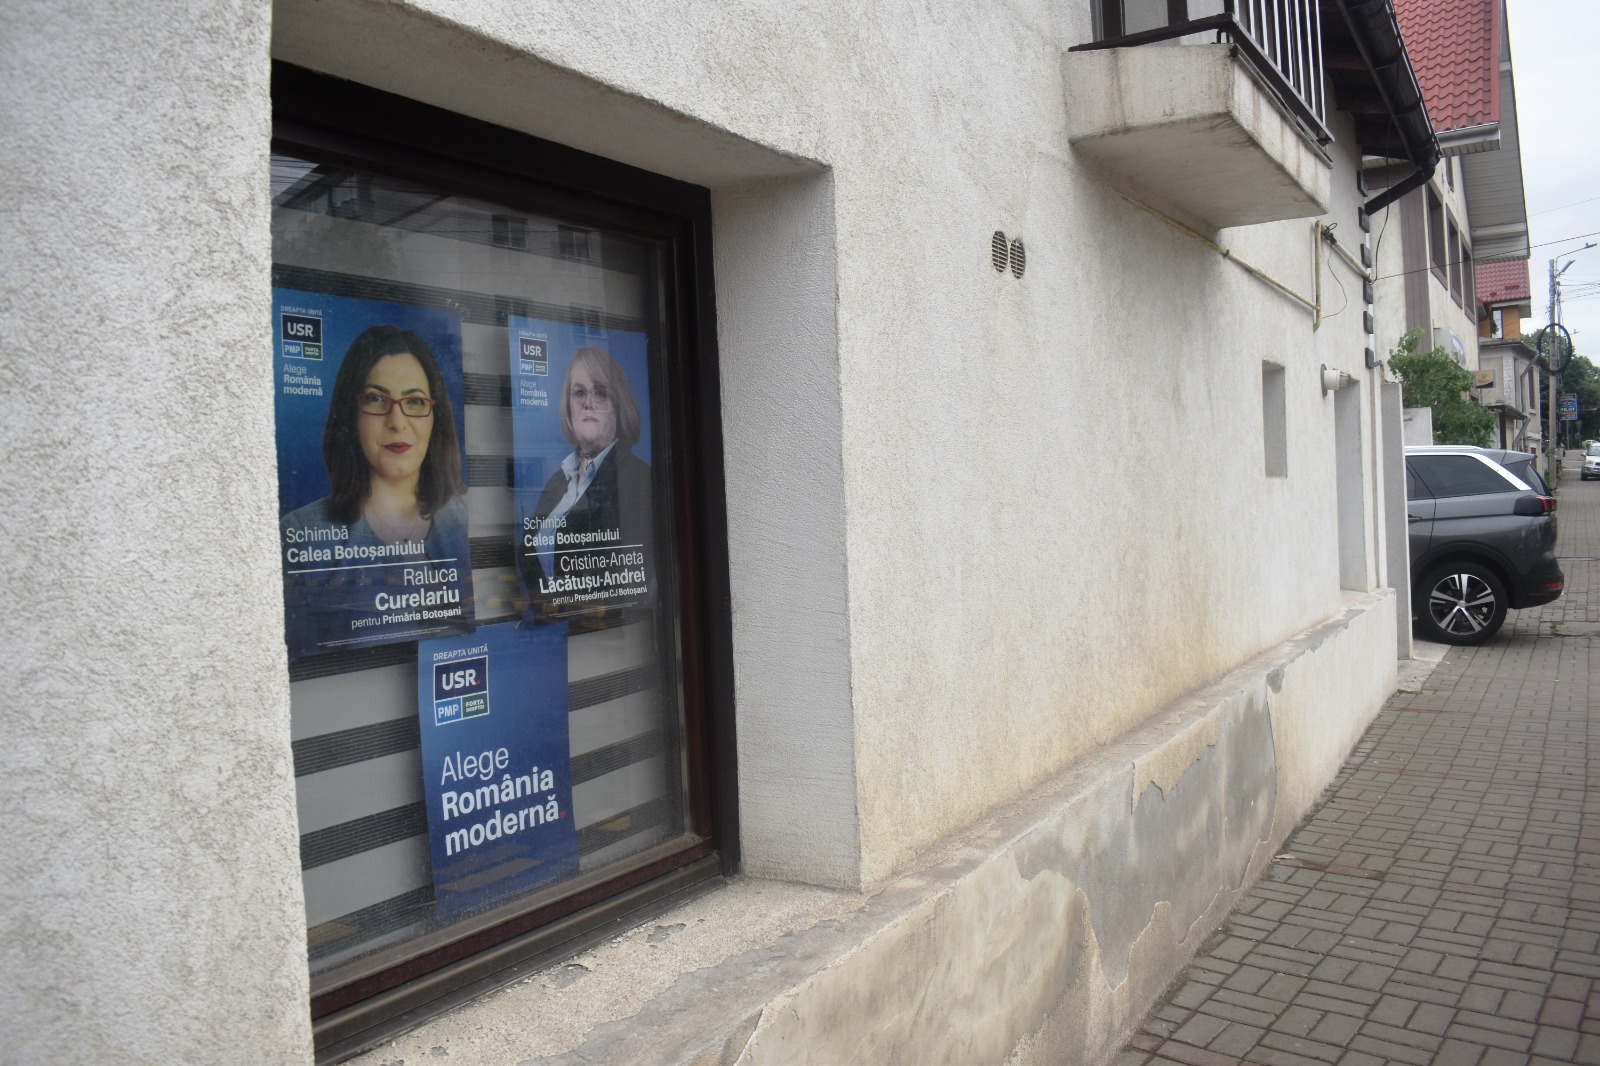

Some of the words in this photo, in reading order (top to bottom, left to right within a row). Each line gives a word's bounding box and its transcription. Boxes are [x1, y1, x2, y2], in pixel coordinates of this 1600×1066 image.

[284, 345, 300, 354] PMP
[284, 364, 306, 376] Alege
[284, 374, 321, 385] România
[524, 516, 567, 530] Schimbă
[286, 525, 349, 543] Schimbă
[524, 532, 555, 547] Calea
[557, 528, 620, 545] Botoșaniului
[287, 547, 332, 563] Calea
[560, 551, 644, 572] Cristina-Aneta
[404, 566, 458, 586] Raluca
[539, 566, 646, 594] Lăcătușu-Andrei
[375, 585, 460, 611] Curelariu
[552, 595, 574, 606] pentru
[609, 588, 618, 597] CJ
[352, 615, 381, 630] pentru
[382, 610, 421, 625] Primăria
[422, 606, 462, 620] Botoșani
[433, 648, 466, 661] DREAPTA
[468, 643, 488, 655] UNITĂ
[438, 704, 459, 719] PMP
[441, 748, 509, 786] Alege
[442, 766, 554, 821] România
